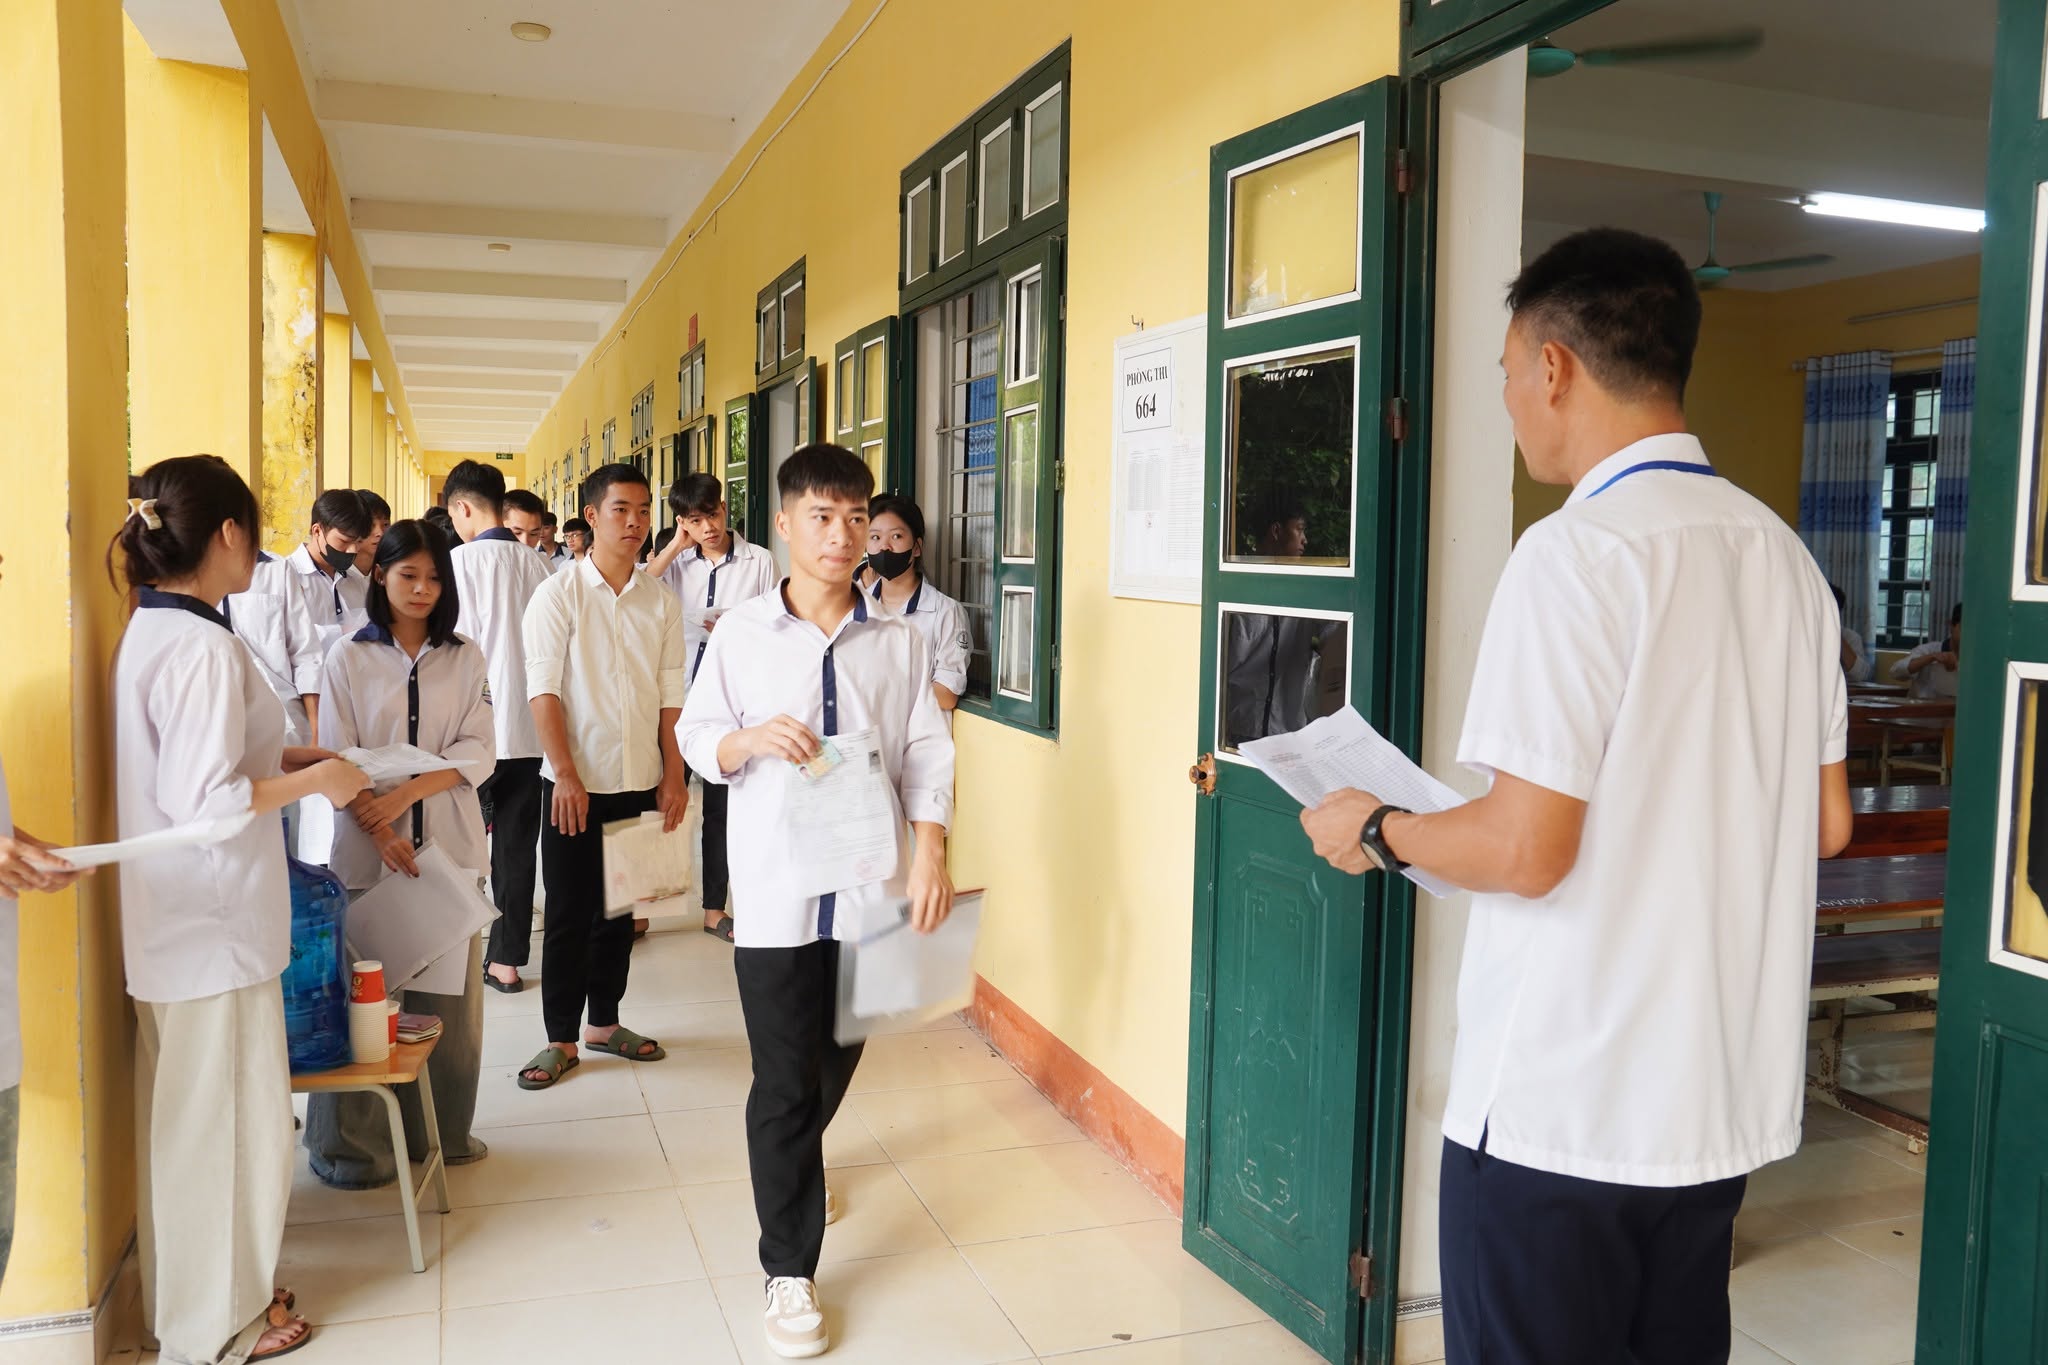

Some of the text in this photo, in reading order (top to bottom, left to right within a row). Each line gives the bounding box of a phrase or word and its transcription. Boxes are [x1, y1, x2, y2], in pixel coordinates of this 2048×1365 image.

[1126, 366, 1168, 387] PHÒNG THI
[1136, 393, 1156, 420] 664
